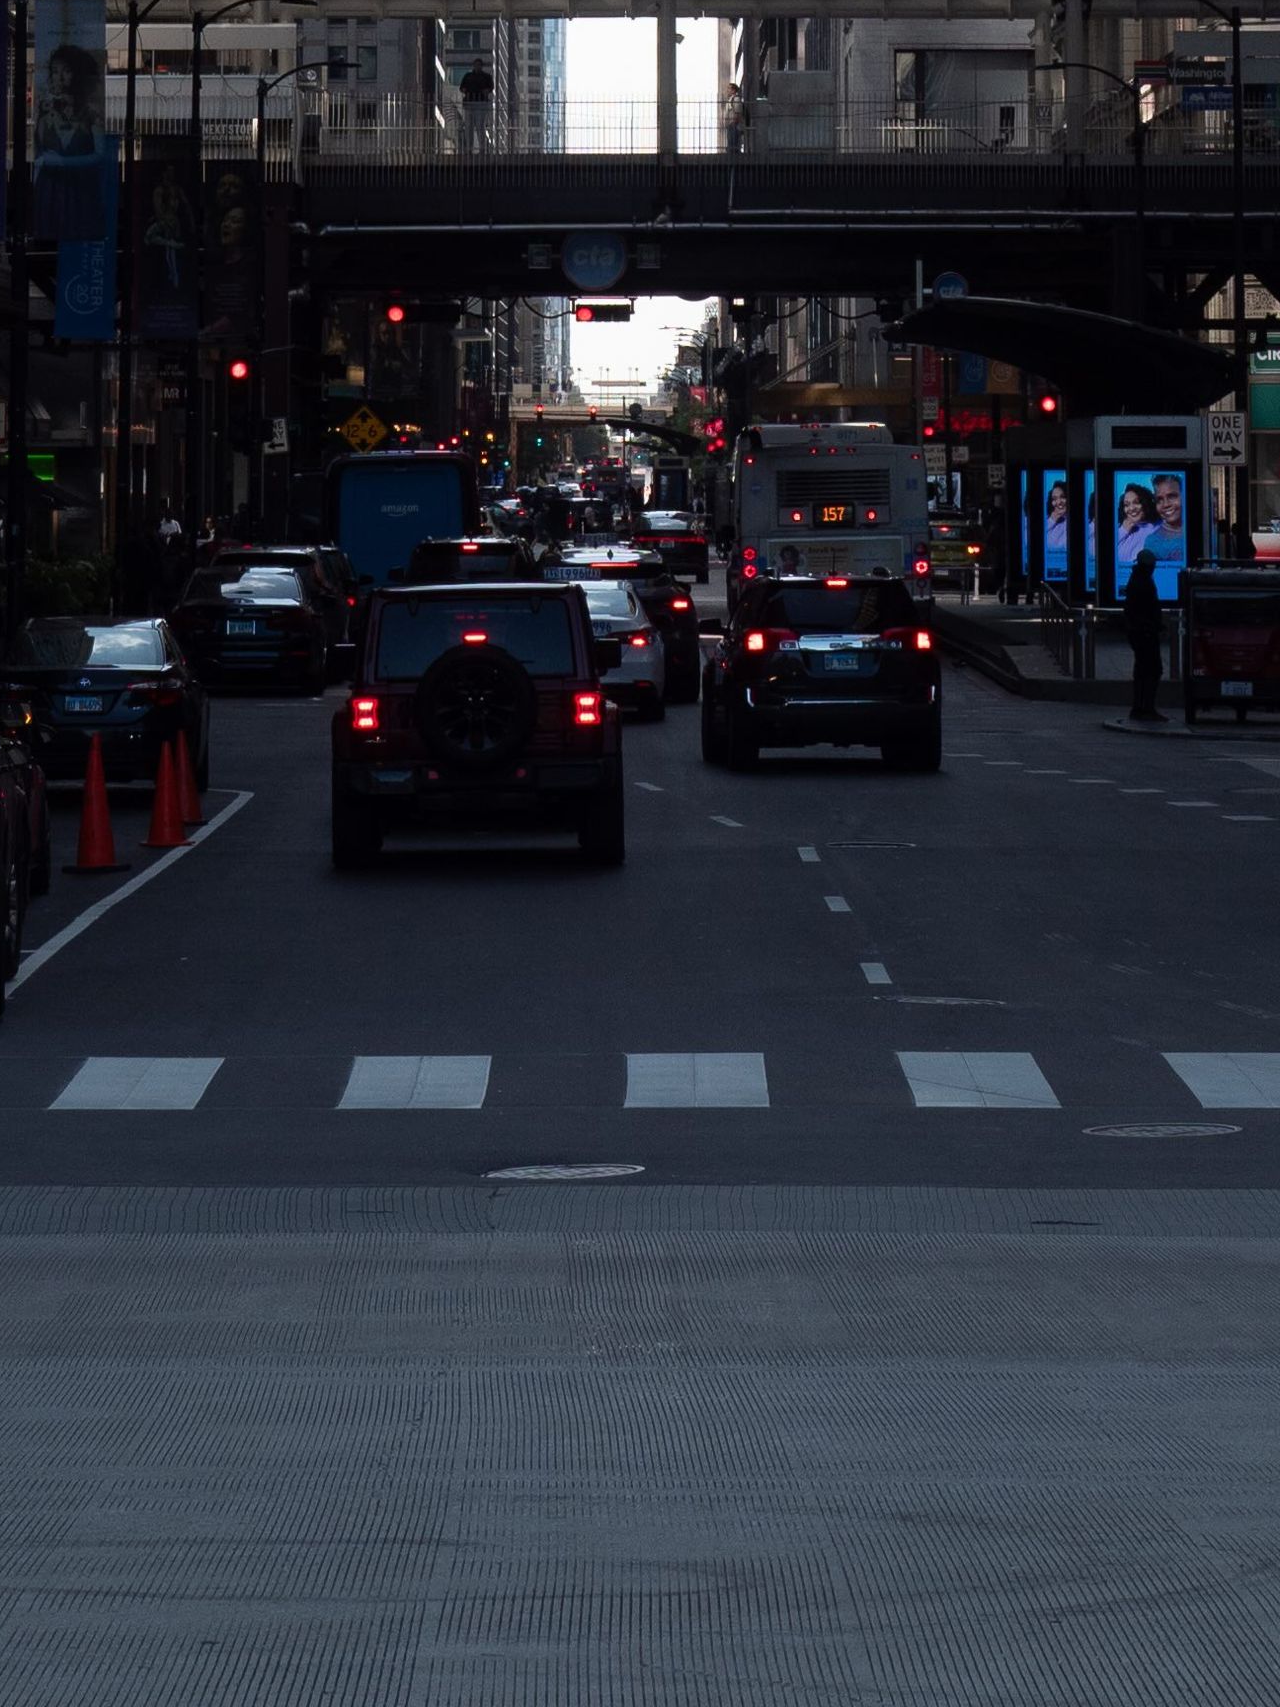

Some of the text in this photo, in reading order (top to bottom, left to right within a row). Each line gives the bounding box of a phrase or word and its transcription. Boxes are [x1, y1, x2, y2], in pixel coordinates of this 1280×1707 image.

[1168, 67, 1225, 81] Washingto
[90, 240, 105, 308] THEATER
[1211, 415, 1242, 429] ONE
[1212, 430, 1243, 444] WAY
[380, 504, 420, 514] amazon
[821, 505, 845, 522] 157
